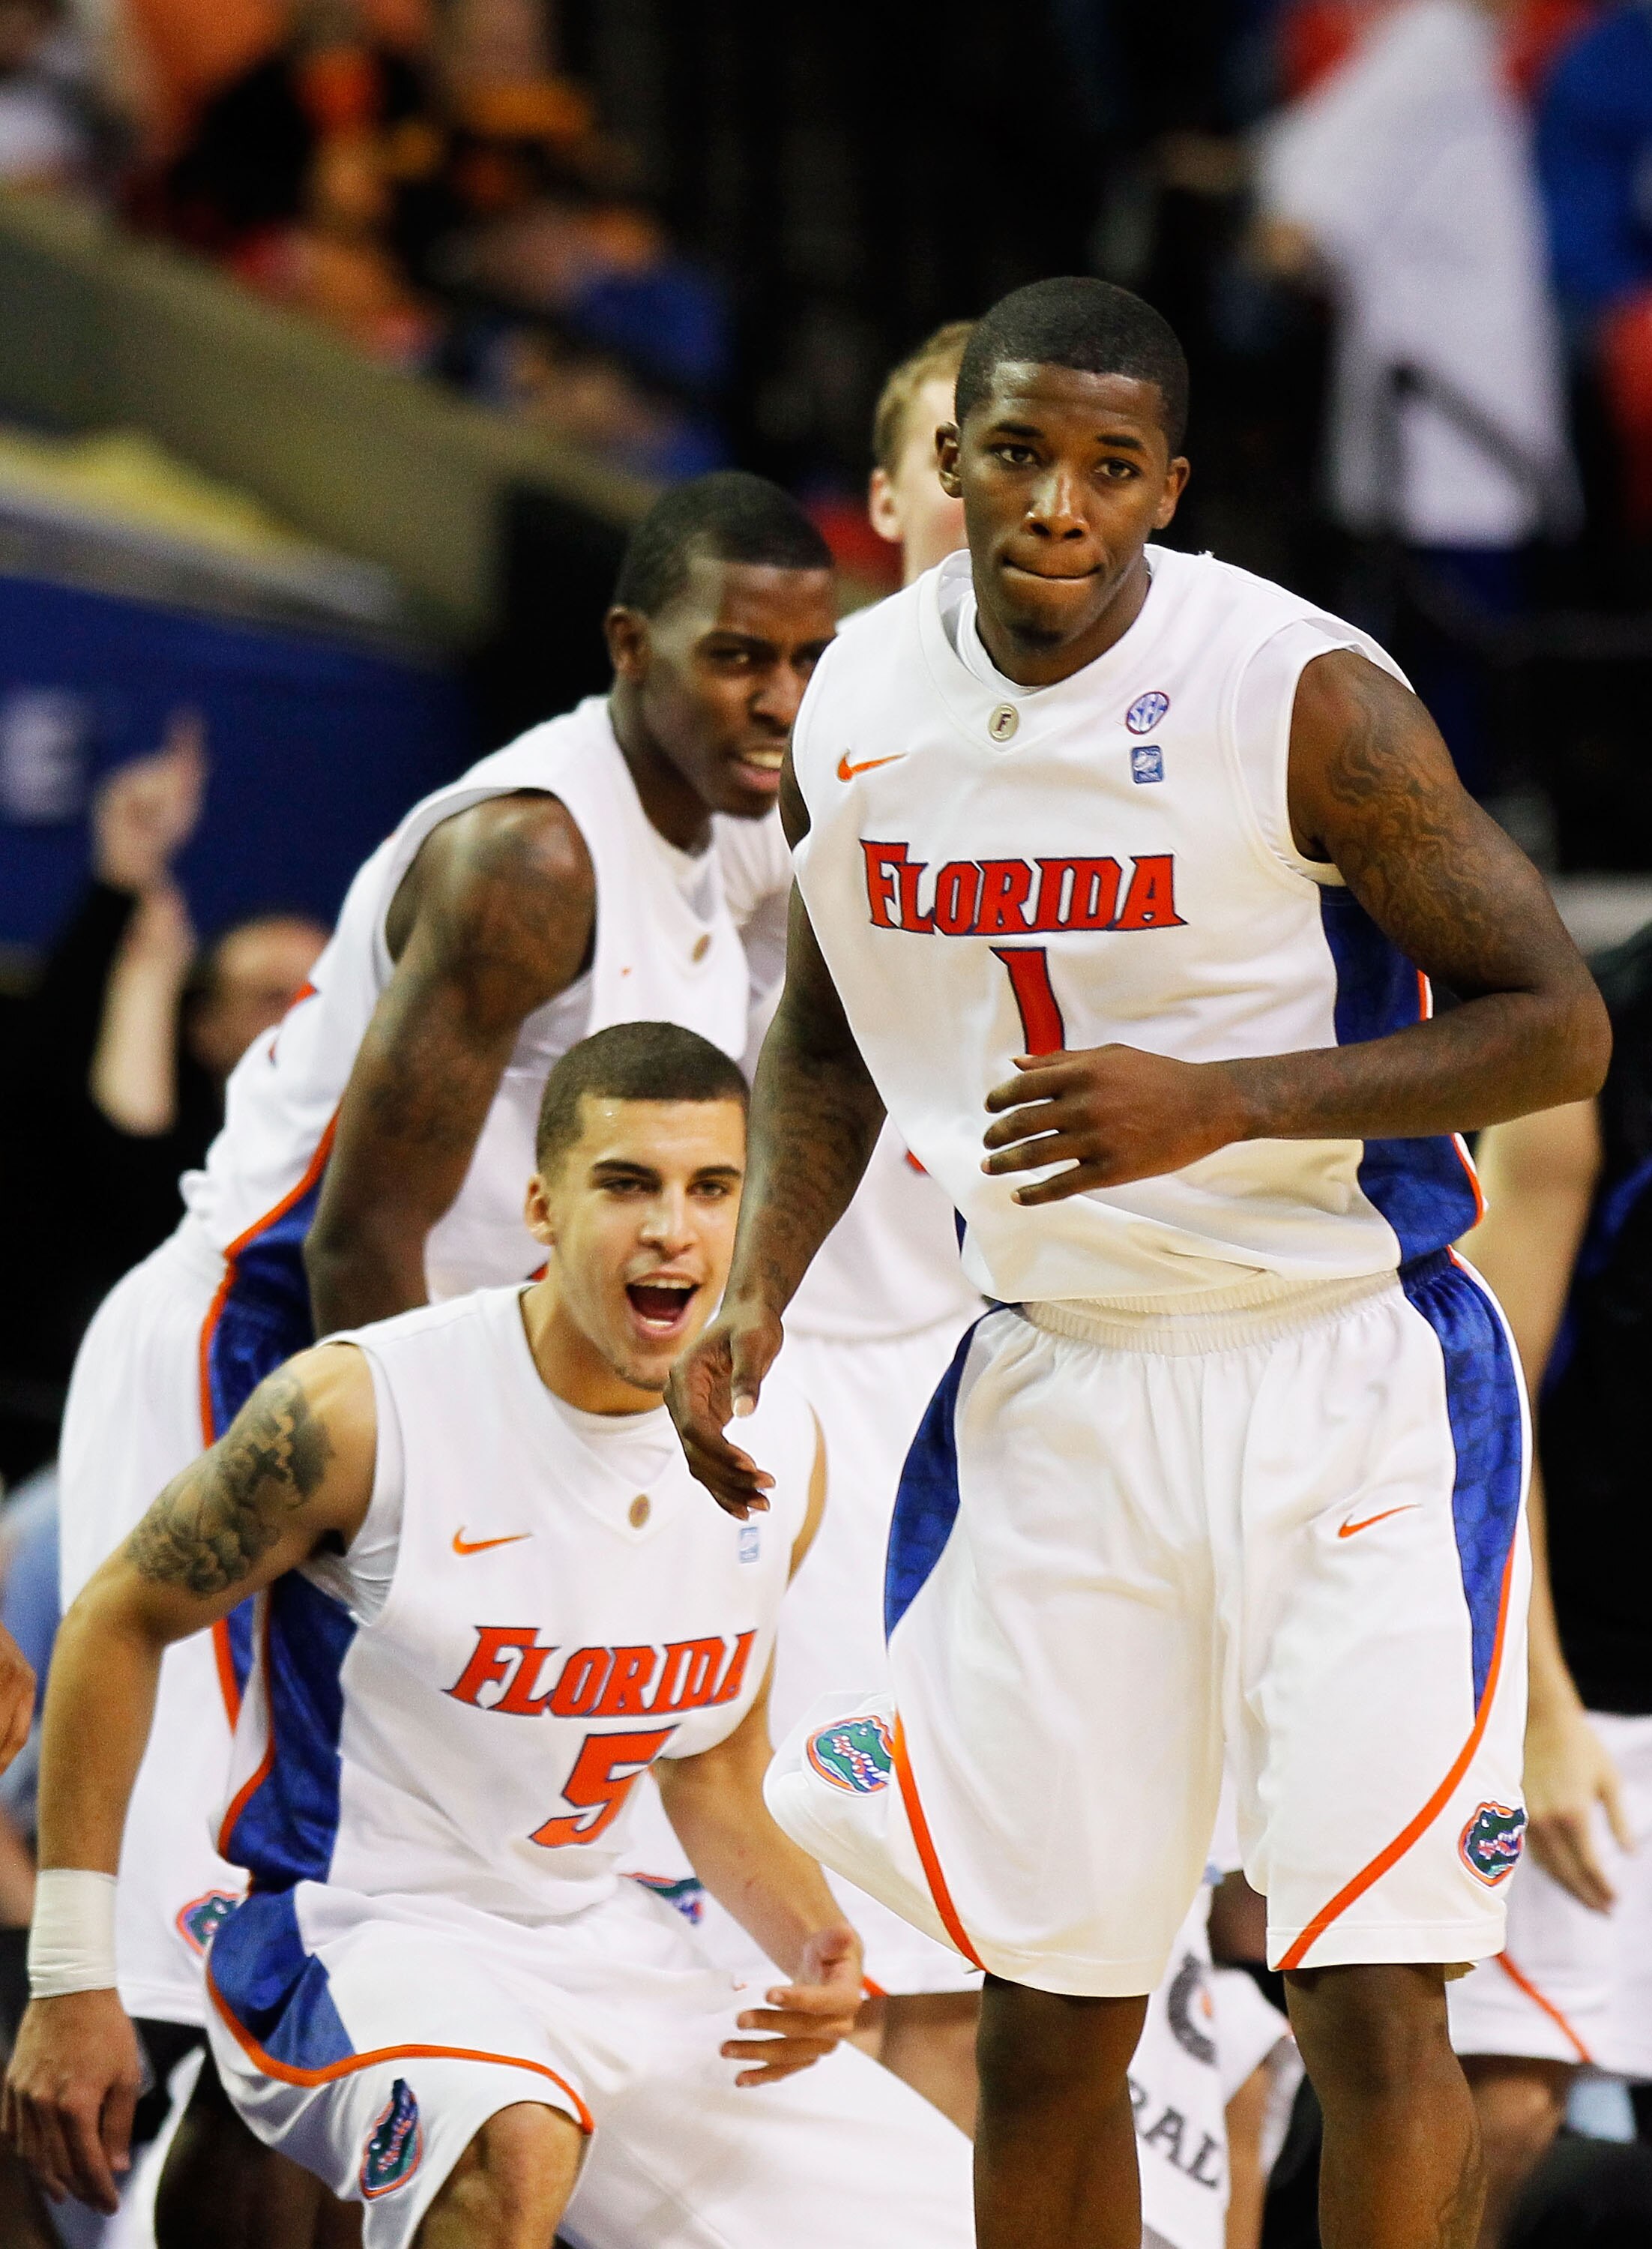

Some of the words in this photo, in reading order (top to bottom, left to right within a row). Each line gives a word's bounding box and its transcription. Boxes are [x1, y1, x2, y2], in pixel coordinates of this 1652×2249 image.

[859, 839, 1189, 936] FLORIDA
[989, 946, 1065, 1056] 1
[528, 1723, 681, 1848] 5
